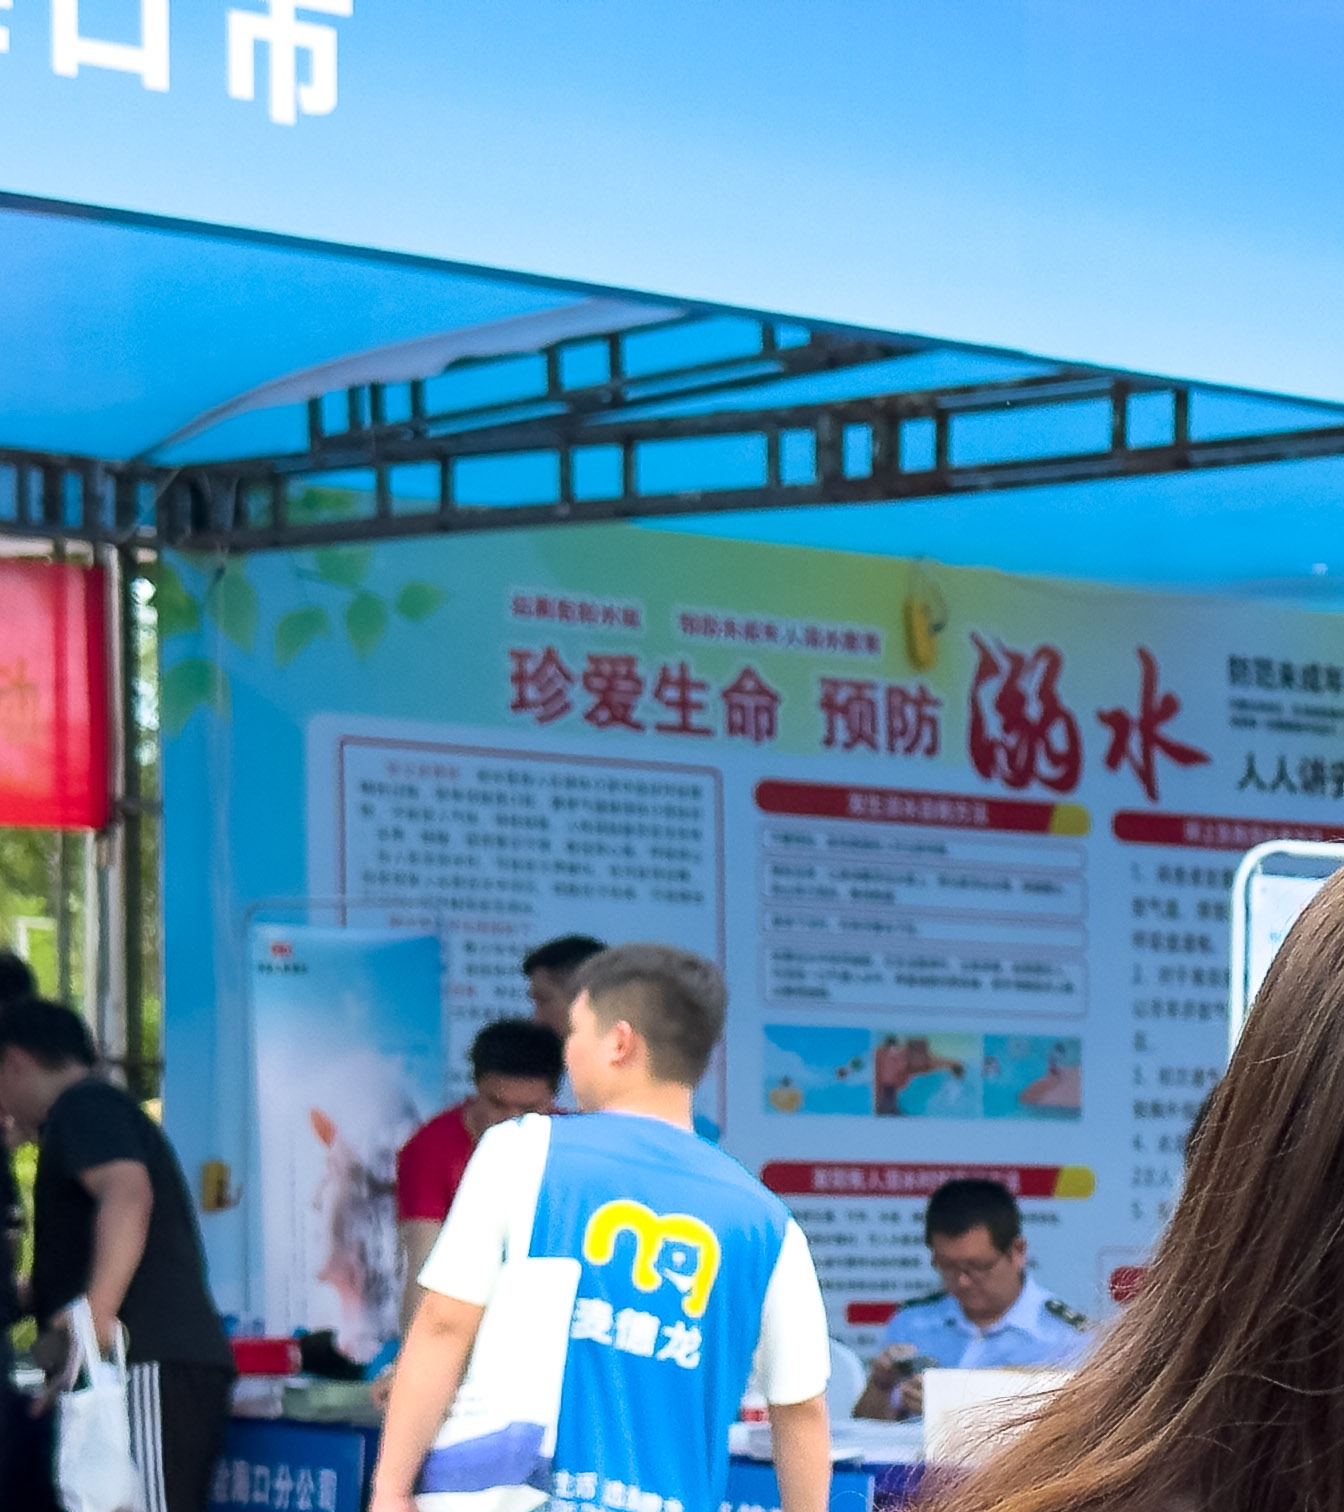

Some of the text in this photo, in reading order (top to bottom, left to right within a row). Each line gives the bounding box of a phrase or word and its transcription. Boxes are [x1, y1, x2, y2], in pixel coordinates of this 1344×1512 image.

[0, 0, 353, 126] 口市
[507, 630, 1213, 800] 珍爱生命 预防 溺水
